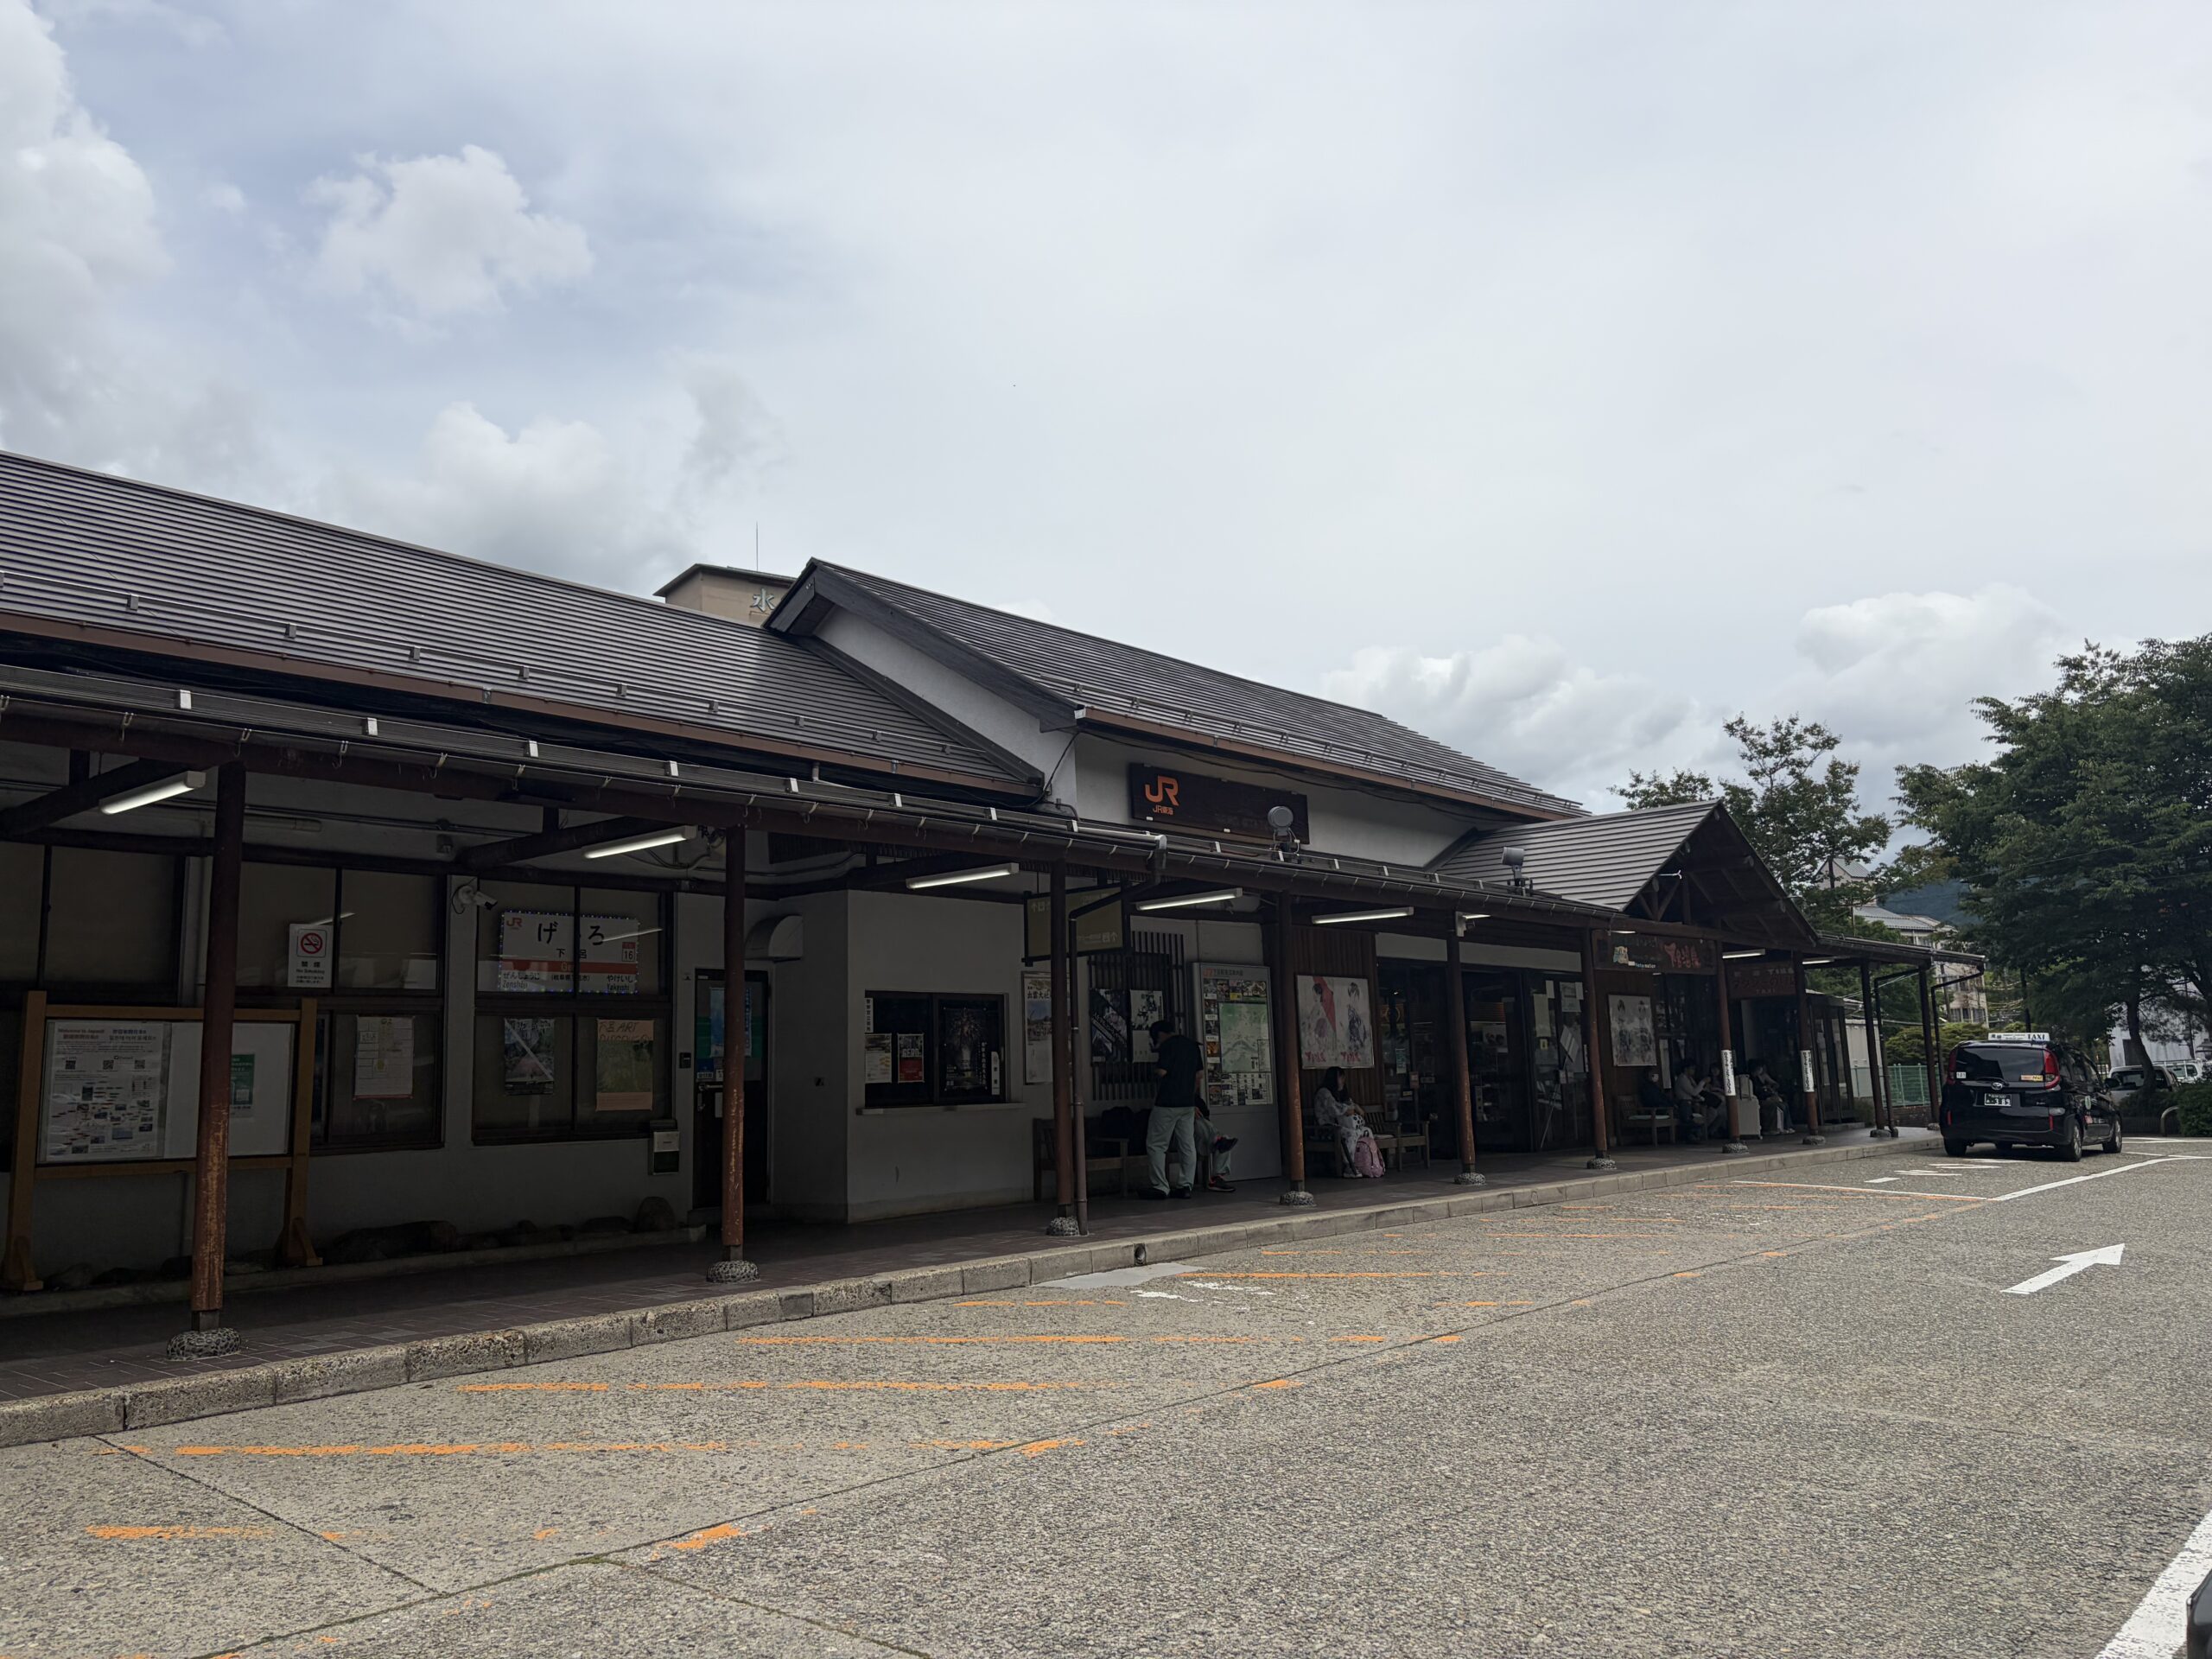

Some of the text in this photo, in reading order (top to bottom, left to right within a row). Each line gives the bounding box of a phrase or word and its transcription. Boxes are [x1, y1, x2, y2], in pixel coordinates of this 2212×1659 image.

[753, 588, 776, 613] 水
[1144, 774, 1179, 806] JR
[506, 917, 523, 927] JR
[625, 950, 633, 960] 16
[607, 974, 633, 983] やけいし
